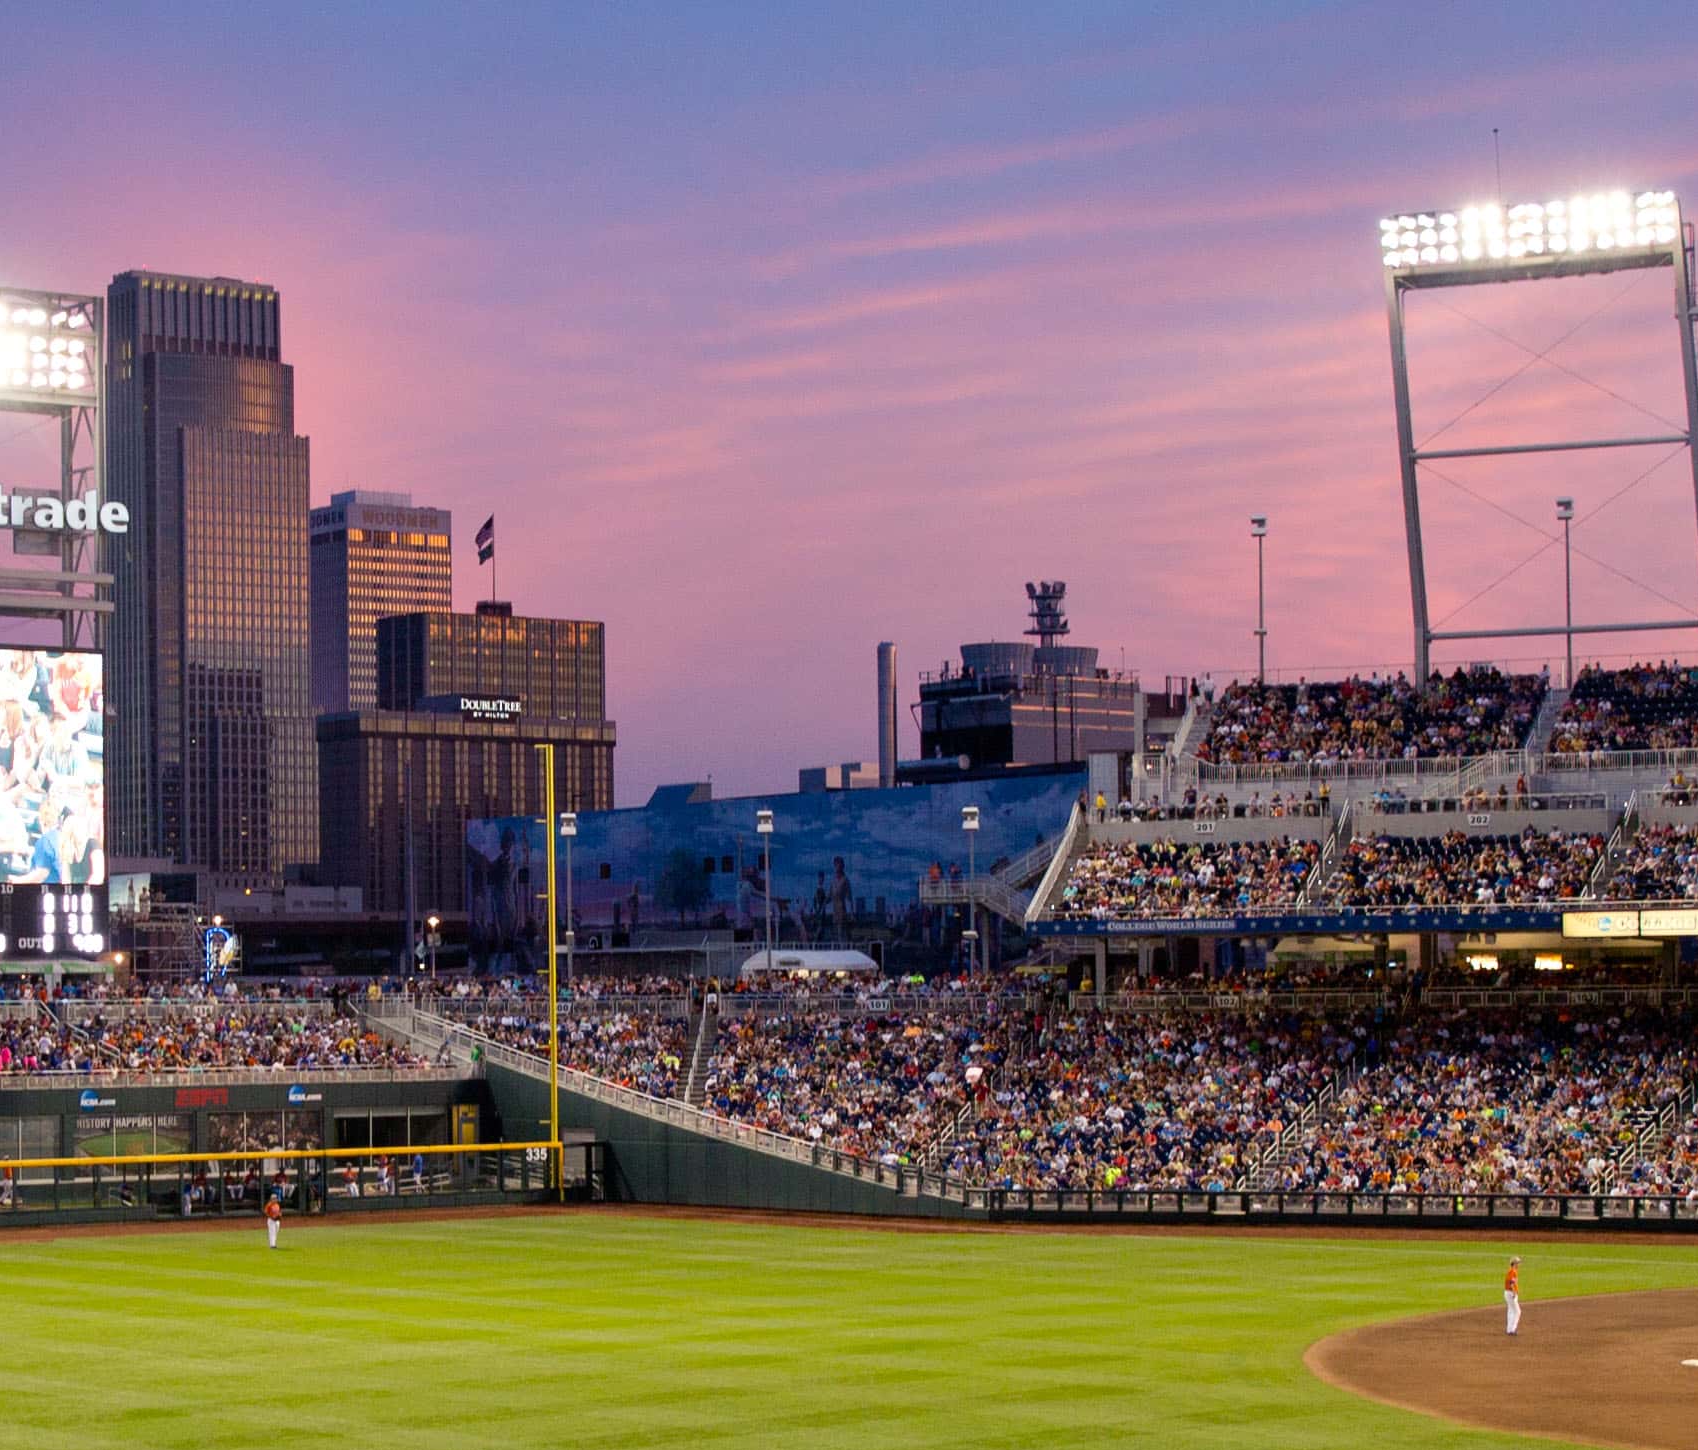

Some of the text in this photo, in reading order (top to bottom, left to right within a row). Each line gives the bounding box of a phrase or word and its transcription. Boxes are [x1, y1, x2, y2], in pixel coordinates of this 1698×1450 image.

[1470, 815, 1488, 825] 202
[1196, 822, 1213, 831] 201
[1107, 920, 1235, 931] COLLEGE WORLD SERIES
[175, 1088, 229, 1107] ESPN
[77, 1115, 179, 1130] HISTORY HAPPENS HERE
[525, 1147, 548, 1161] 335
